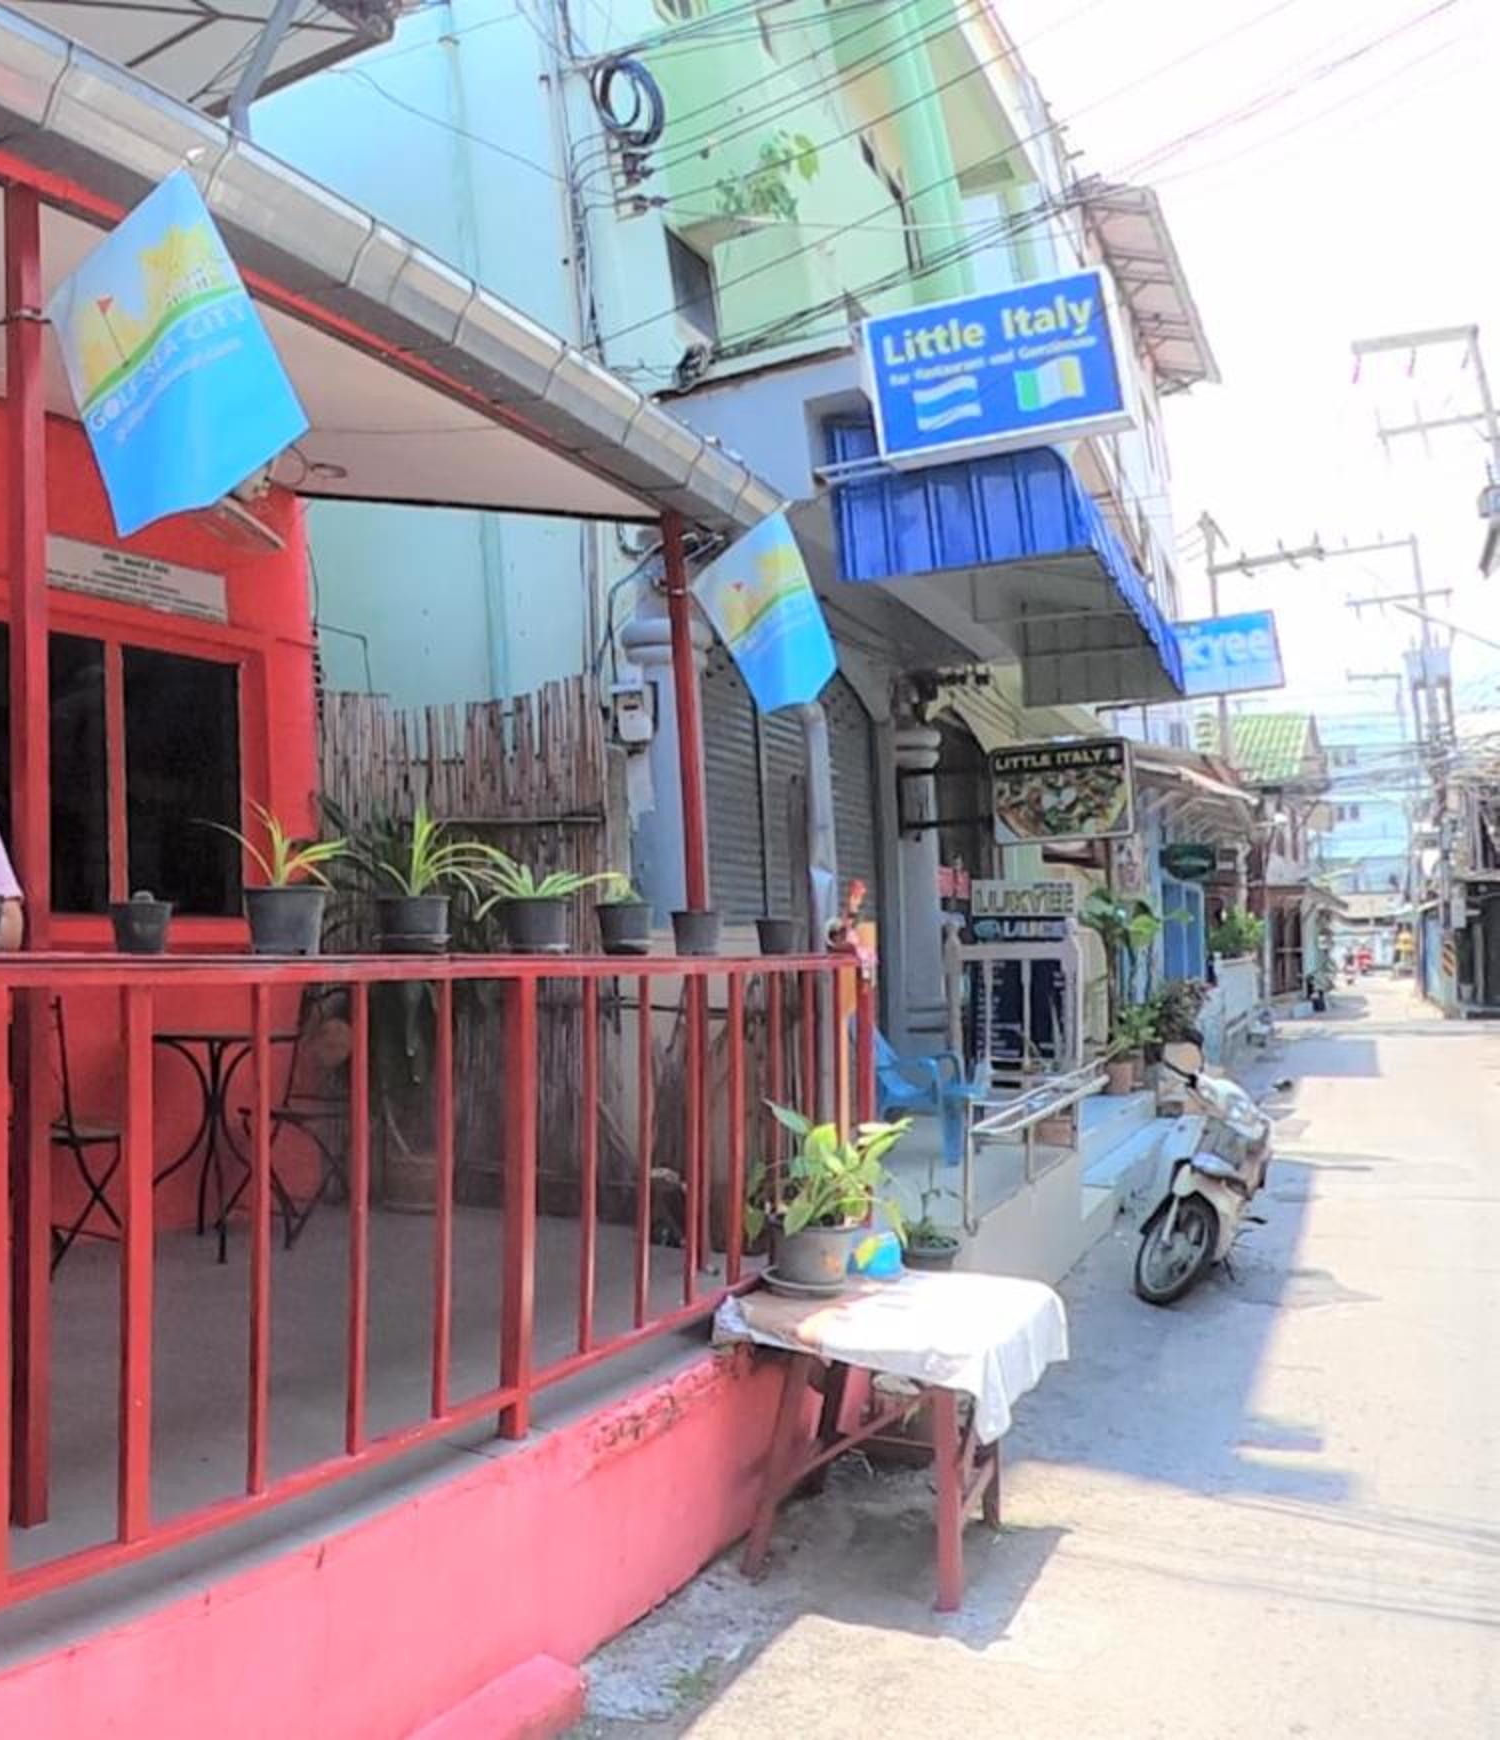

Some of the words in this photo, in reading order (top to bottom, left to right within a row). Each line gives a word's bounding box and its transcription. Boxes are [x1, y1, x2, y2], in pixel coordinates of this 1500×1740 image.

[883, 317, 986, 366] Little
[1002, 293, 1093, 341] Italy
[995, 753, 1052, 771] LITTLE
[1056, 748, 1102, 765] ITALY
